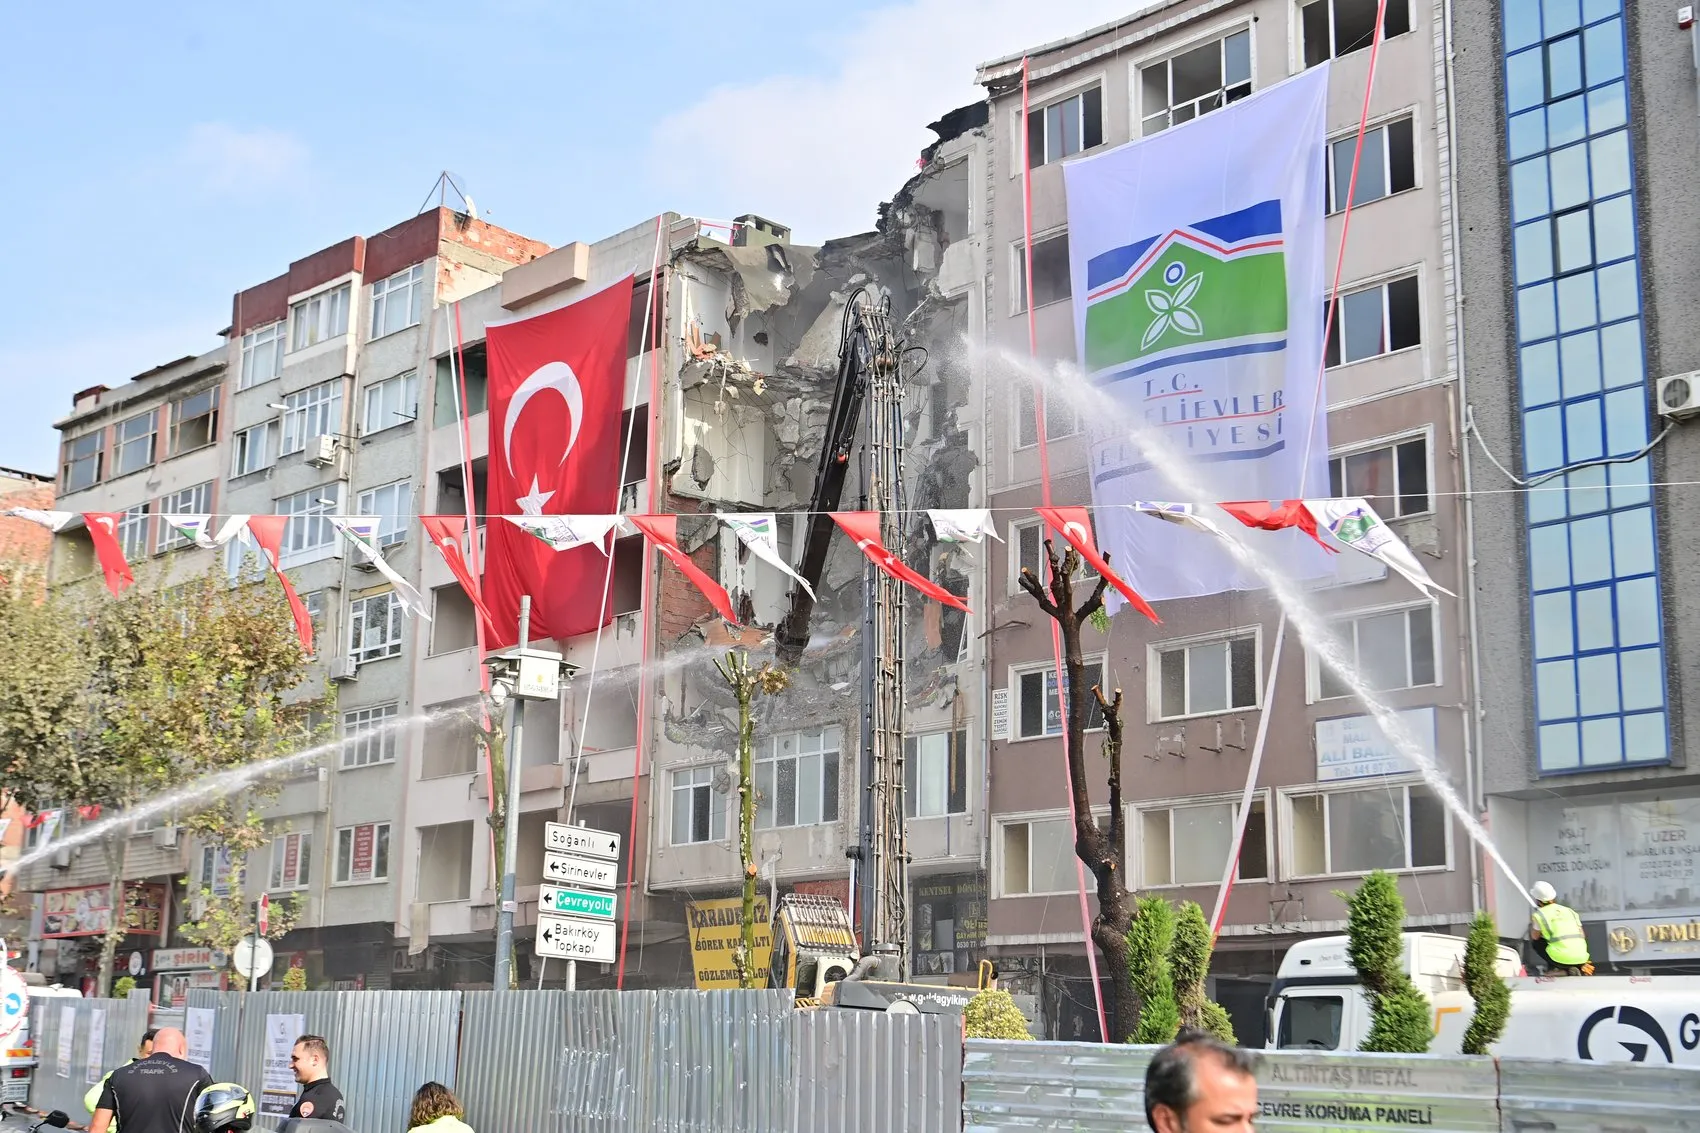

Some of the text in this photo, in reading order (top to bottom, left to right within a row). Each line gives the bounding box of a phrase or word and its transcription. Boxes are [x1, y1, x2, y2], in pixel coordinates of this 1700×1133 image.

[552, 831, 595, 849] Soğanlı
[561, 863, 607, 881] Şirinevler
[557, 892, 612, 912] Çevreyolu
[555, 923, 600, 942] Bakırköy
[1646, 919, 1700, 943] PEMİ
[555, 938, 595, 954] Topkapı
[1358, 1068, 1418, 1088] METAL
[1306, 1104, 1372, 1122] KORUMA
[1376, 1105, 1433, 1125] PANELİ
